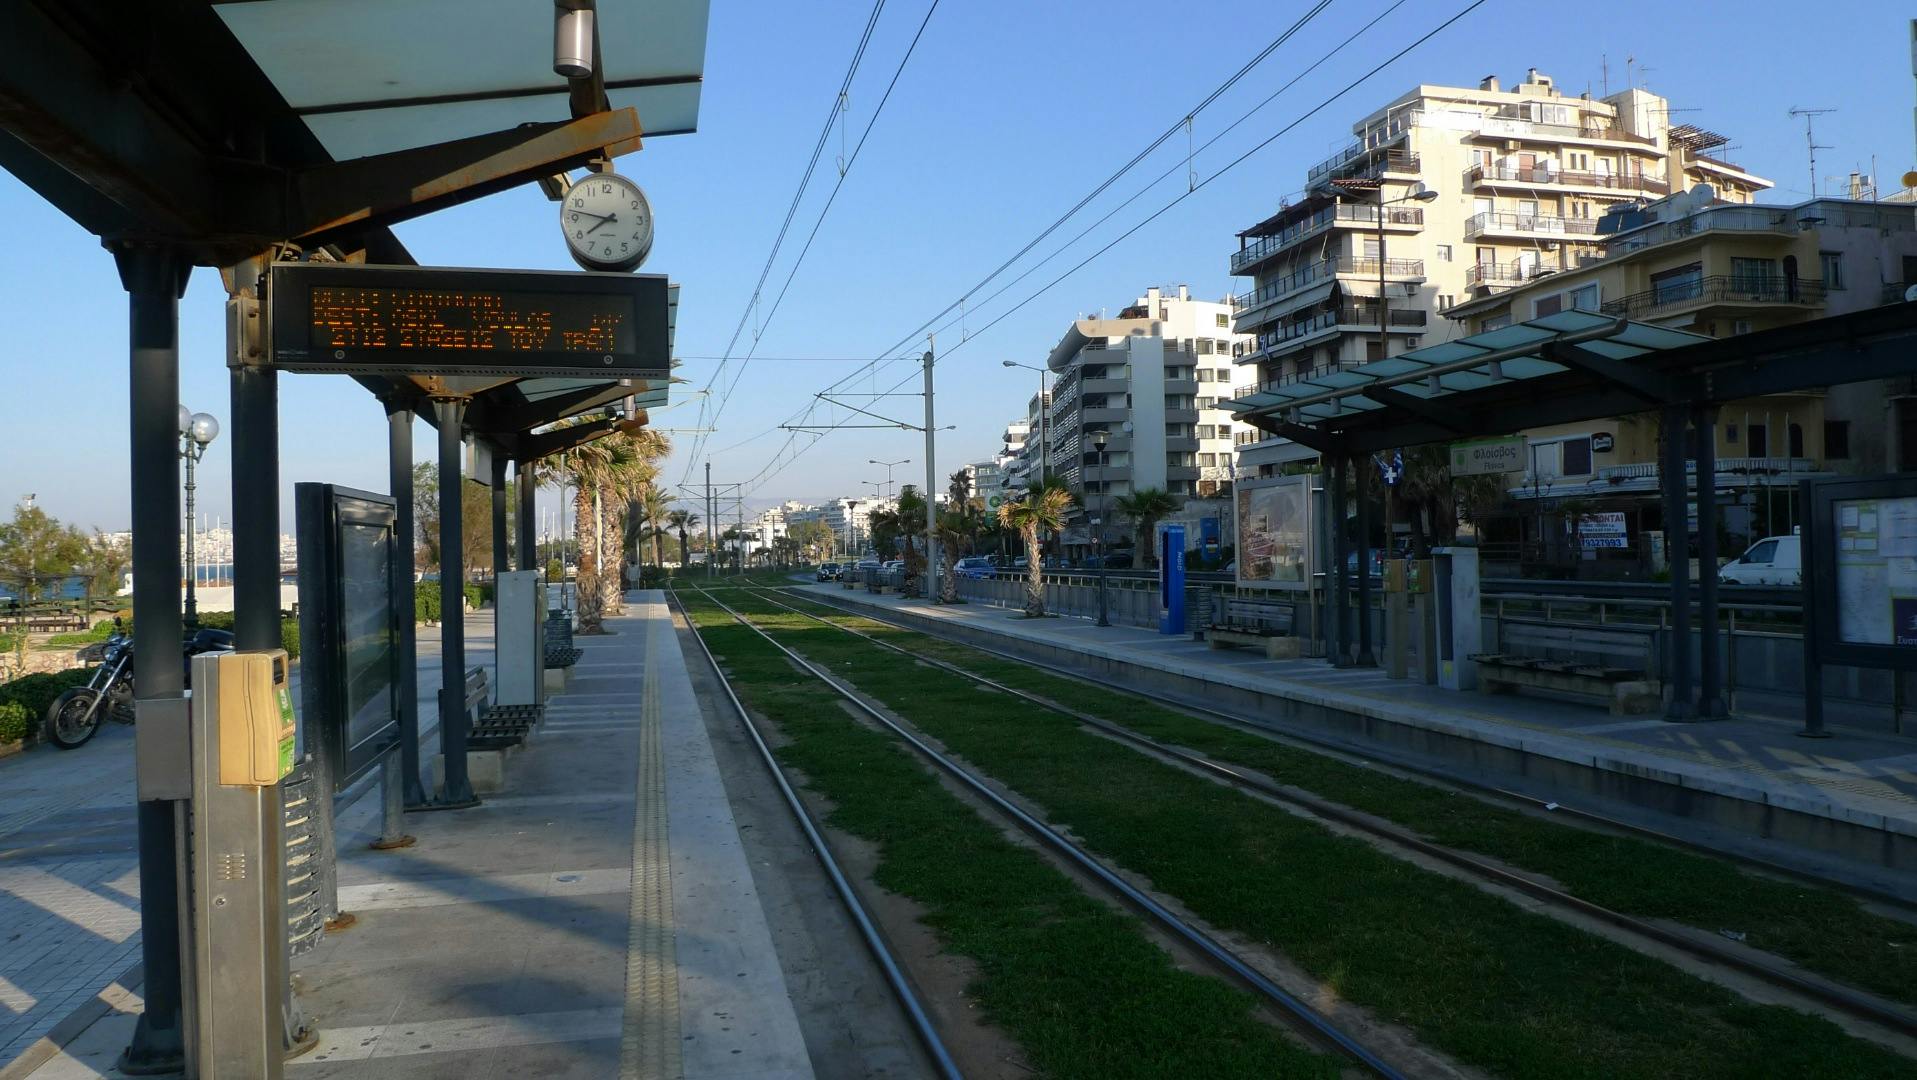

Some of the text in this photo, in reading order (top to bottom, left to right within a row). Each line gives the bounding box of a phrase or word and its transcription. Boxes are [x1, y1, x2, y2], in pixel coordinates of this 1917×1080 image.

[587, 186, 596, 197] 11
[602, 183, 612, 194] 12
[574, 198, 584, 208] 10
[631, 200, 639, 210] 2
[571, 214, 579, 223] 9
[636, 216, 643, 226] 3
[576, 230, 583, 240] 8
[632, 232, 639, 241] 4
[588, 241, 596, 251] 7
[604, 246, 612, 256] 6
[620, 242, 628, 252] 5
